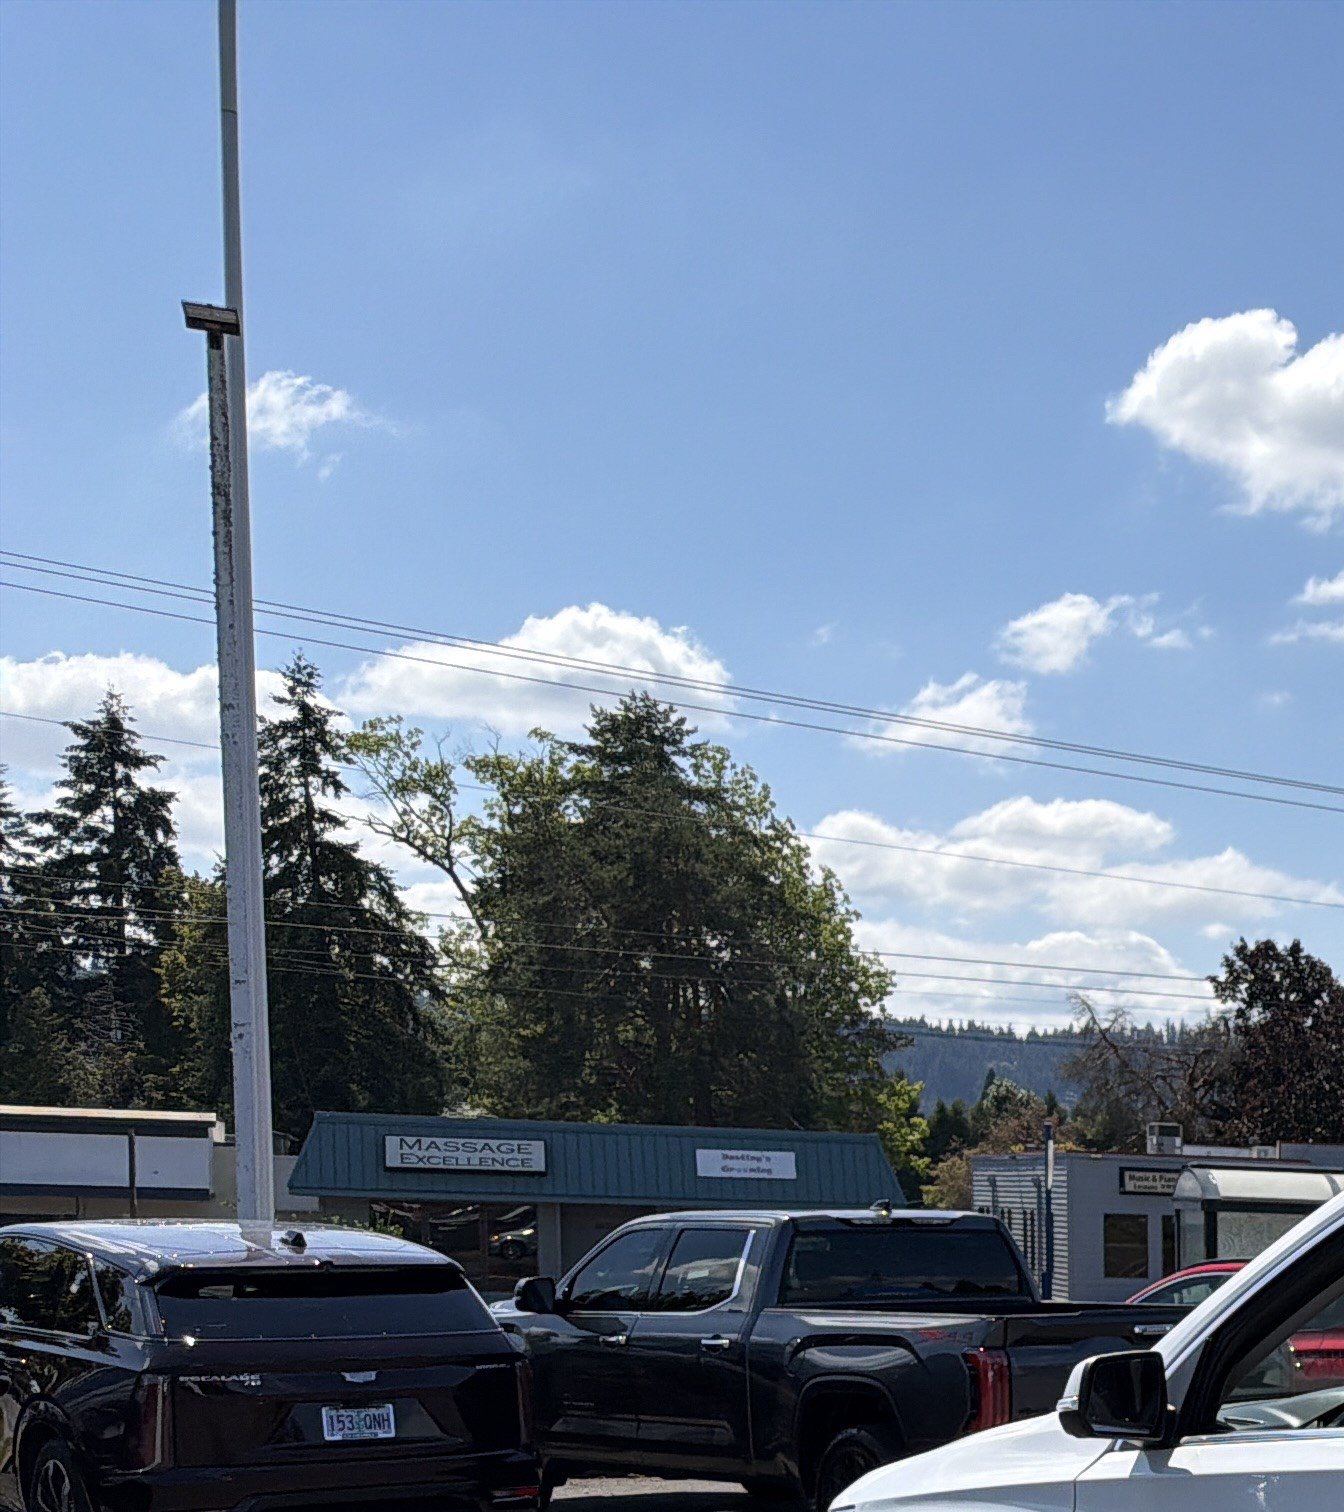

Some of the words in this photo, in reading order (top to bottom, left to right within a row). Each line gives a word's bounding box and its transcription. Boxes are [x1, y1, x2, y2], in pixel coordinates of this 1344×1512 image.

[399, 1137, 533, 1155] MASSAGE
[400, 1153, 533, 1168] EXCELLENCE
[329, 1413, 355, 1432] 153
